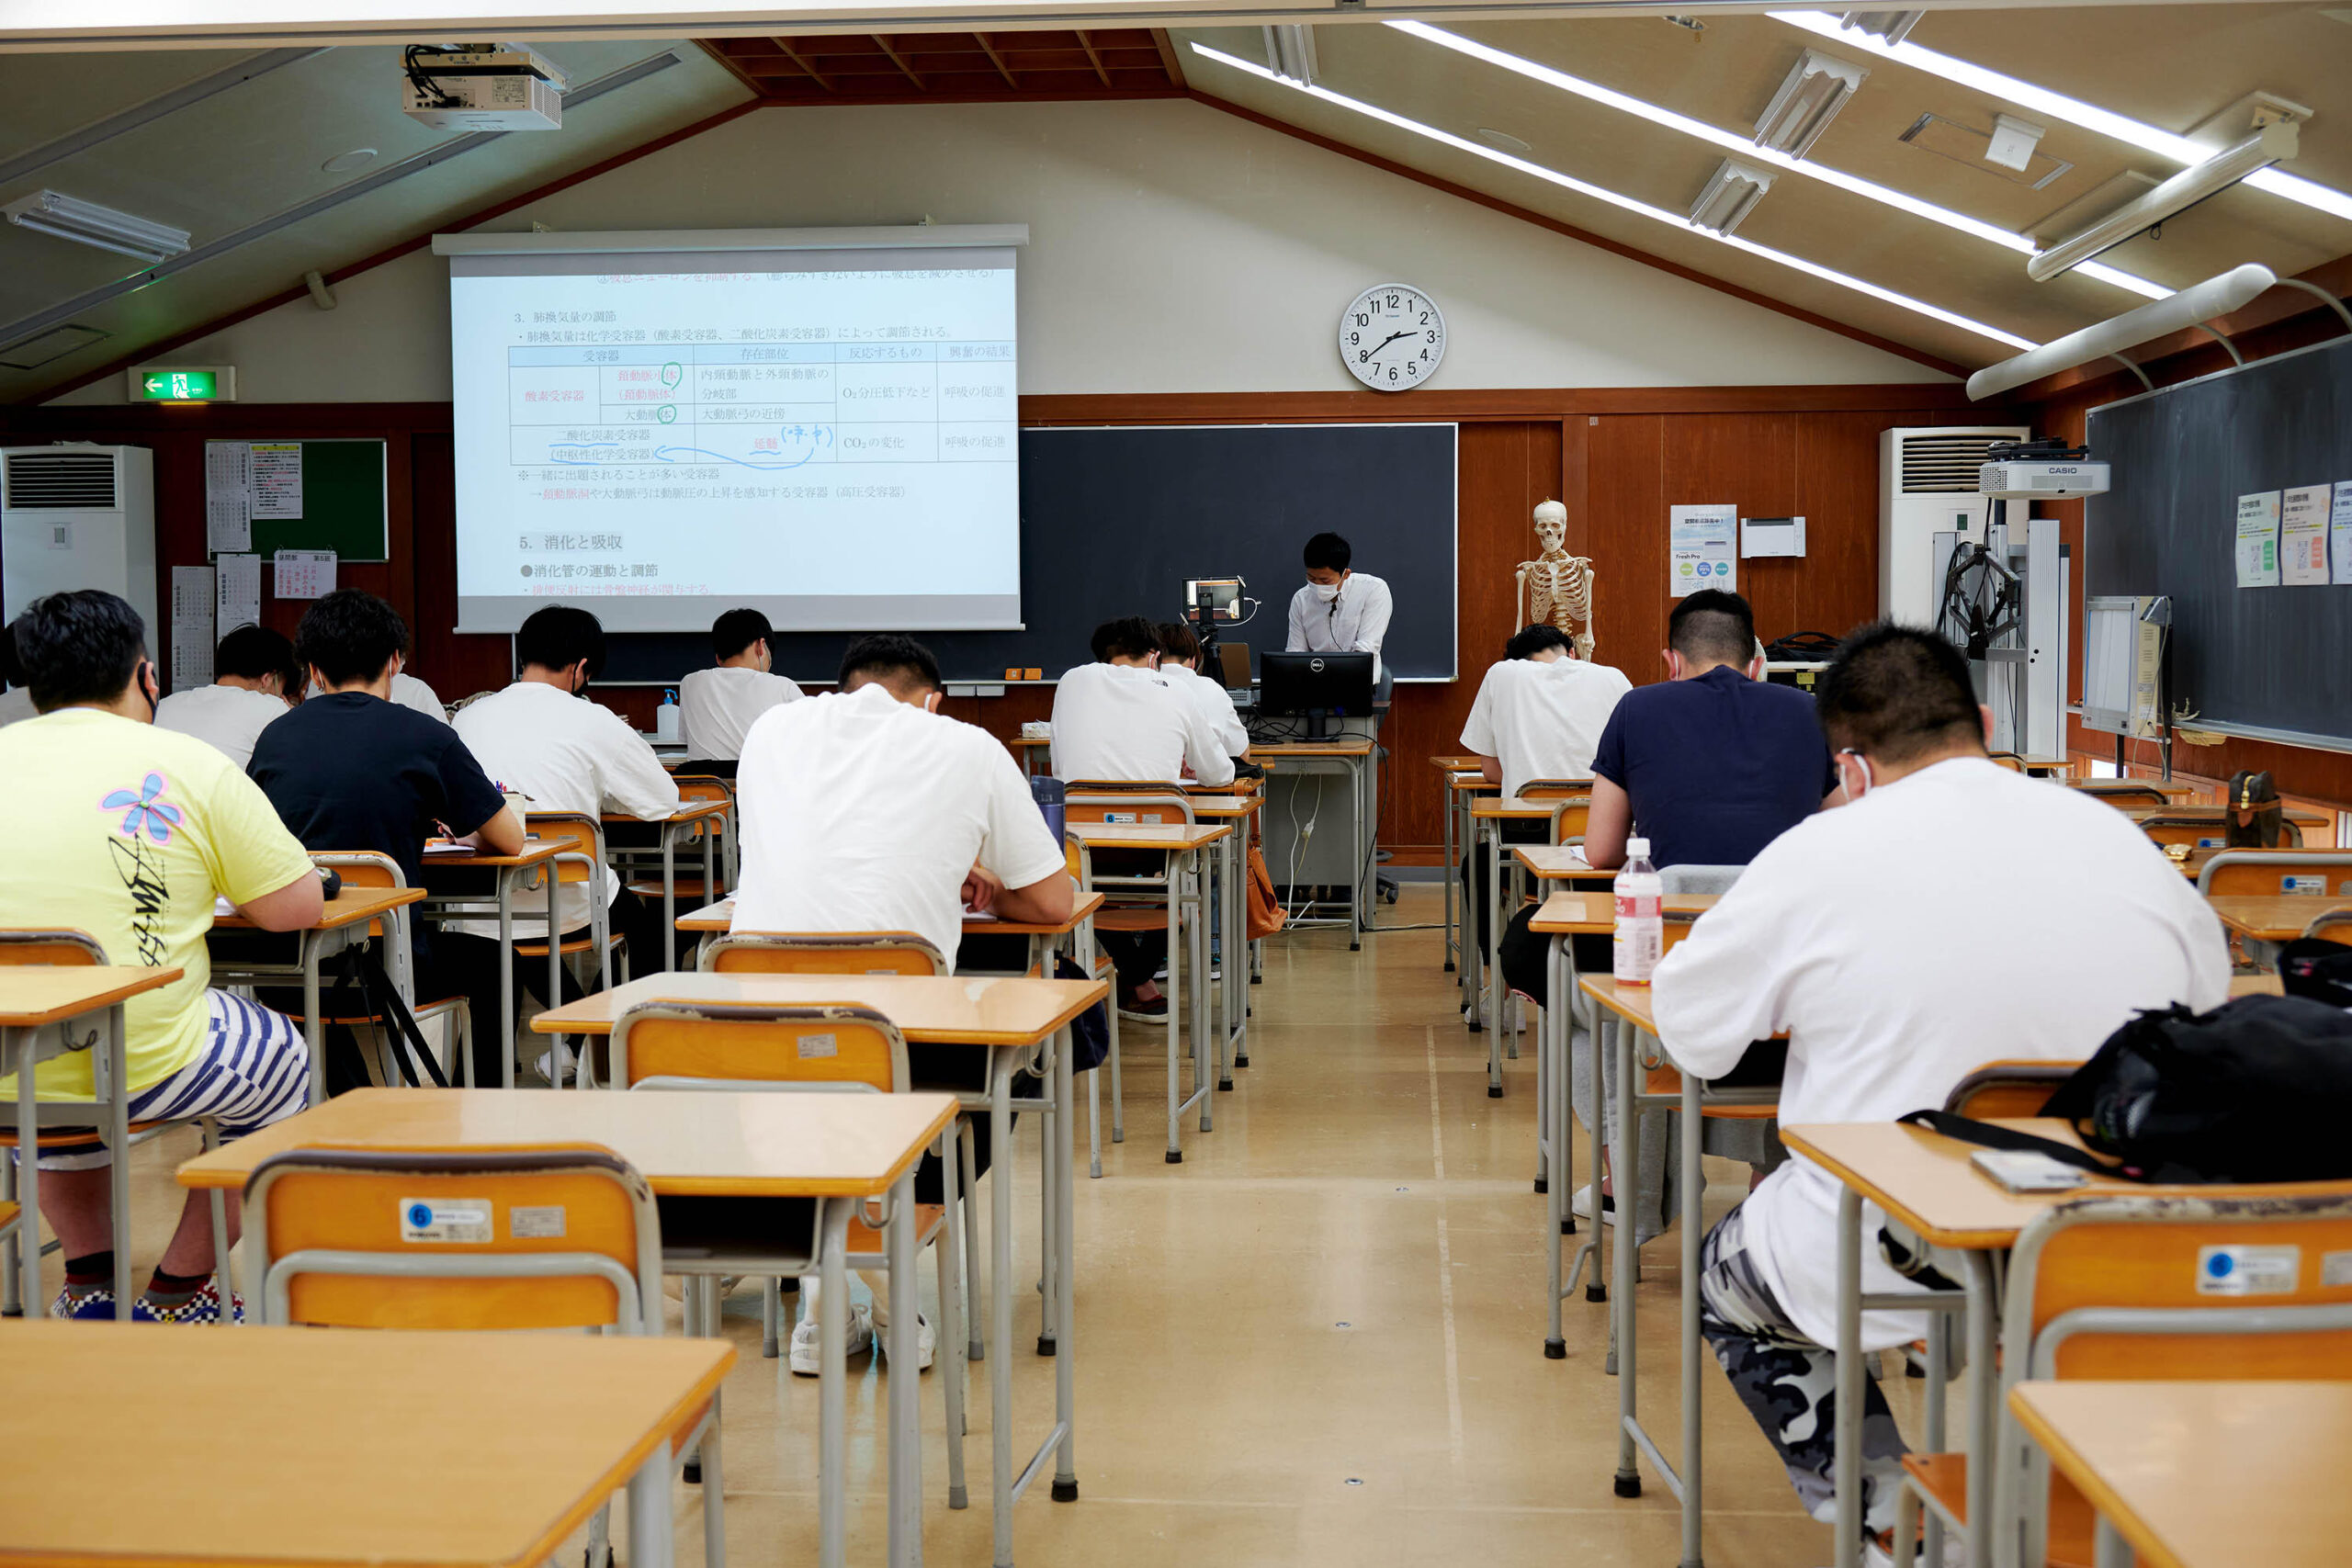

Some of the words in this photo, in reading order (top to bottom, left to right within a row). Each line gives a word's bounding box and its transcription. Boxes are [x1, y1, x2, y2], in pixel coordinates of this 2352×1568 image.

[1370, 300, 1380, 314] 11
[1386, 295, 1399, 309] 12
[1408, 299, 1413, 313] 1
[1355, 313, 1369, 327] 10
[1419, 311, 1429, 325] 2
[1351, 332, 1360, 345] 9
[1427, 330, 1435, 344] 3
[583, 350, 620, 362] 受容器
[741, 348, 789, 360] 存在部位
[849, 346, 922, 359] 反応するもの
[948, 345, 1011, 357] 興奮の結果
[1360, 350, 1368, 363] 8
[1419, 348, 1429, 362] 4
[1373, 363, 1381, 376] 7
[1388, 367, 1398, 380] 6
[1408, 361, 1417, 375] 5
[525, 389, 584, 402] 酸素受容器
[702, 388, 737, 400] 分岐部
[944, 386, 1006, 399] 呼吸の促進
[944, 436, 1007, 448] 呼吸の促進
[544, 535, 623, 550] 消化と吸収
[413, 1207, 426, 1225] 6
